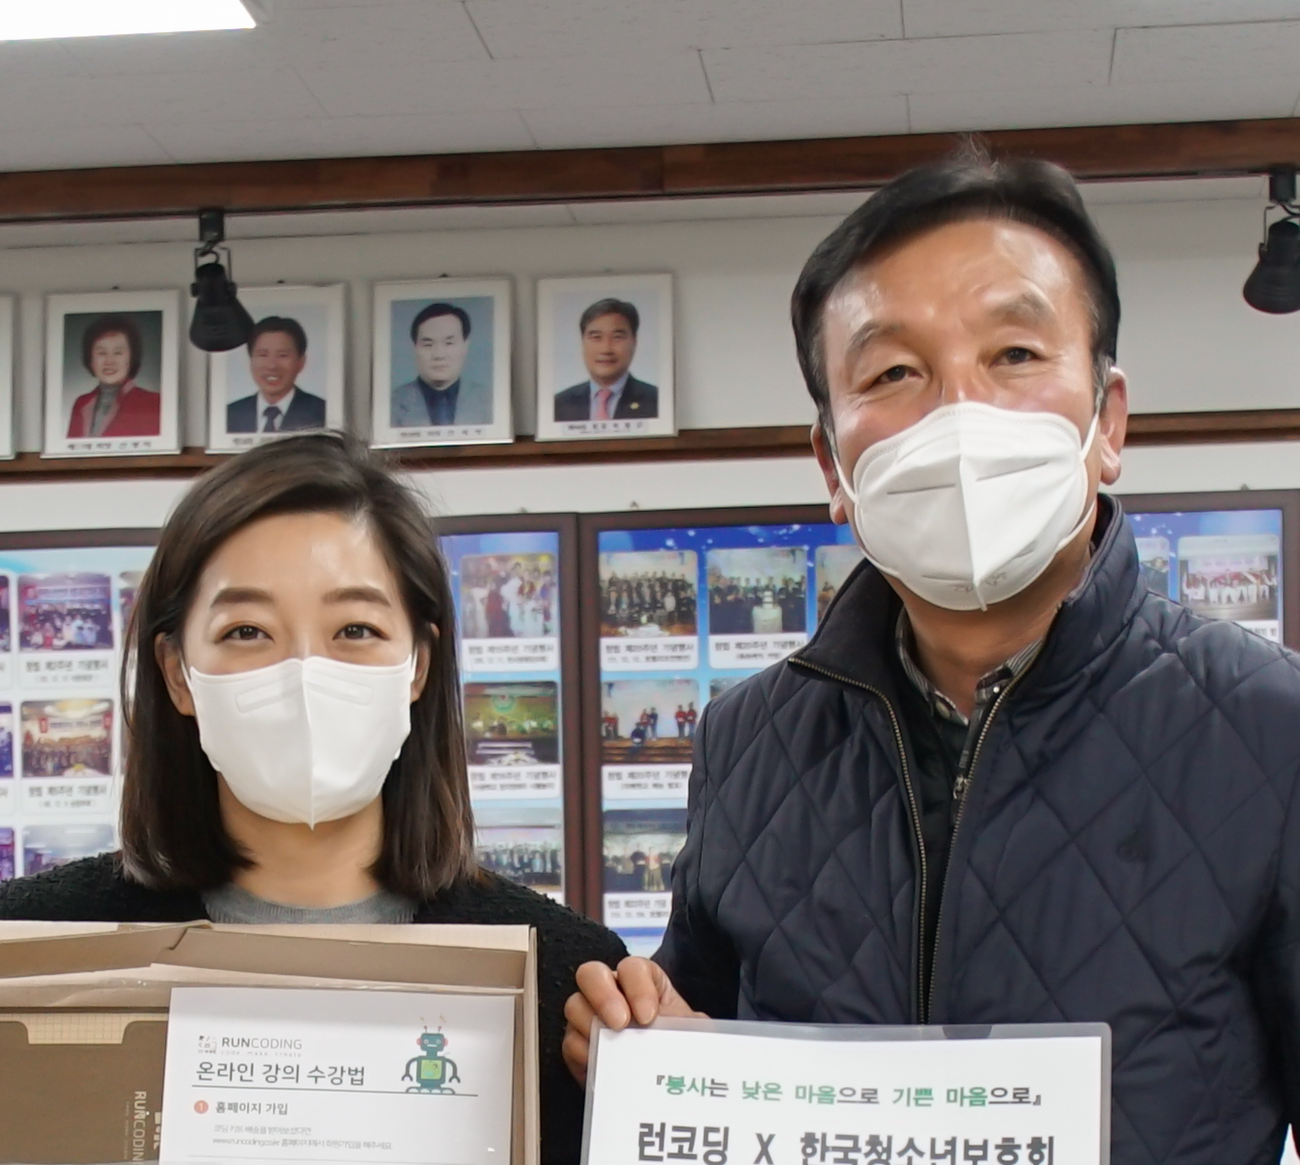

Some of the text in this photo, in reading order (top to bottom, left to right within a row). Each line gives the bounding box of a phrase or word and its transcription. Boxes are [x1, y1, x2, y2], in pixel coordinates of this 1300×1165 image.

[221, 1036, 303, 1050] RUNCODING
[196, 1061, 365, 1086] 온라인 강의 수강법
[741, 1079, 783, 1102] 낮은
[795, 1083, 880, 1105] 마음으로
[892, 1086, 934, 1107] 기쁜
[215, 1101, 262, 1115] 홈페이지
[265, 1102, 288, 1115] 가입
